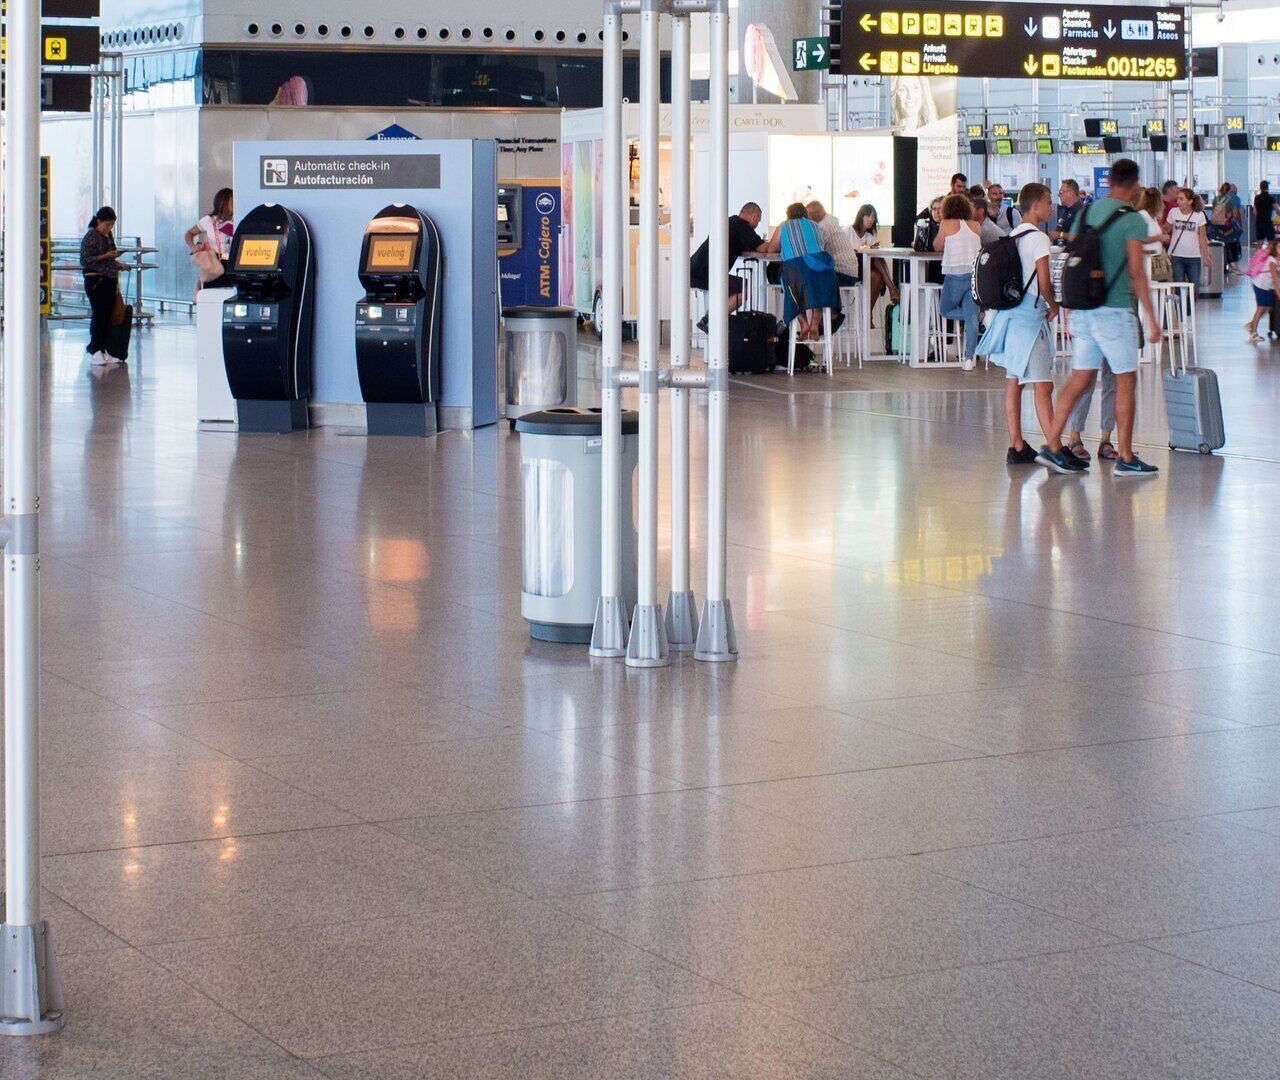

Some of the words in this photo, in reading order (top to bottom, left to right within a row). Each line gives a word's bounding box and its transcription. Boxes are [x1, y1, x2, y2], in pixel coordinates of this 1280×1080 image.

[1062, 28, 1099, 39] Farmacia
[1156, 31, 1179, 40] Aseos
[923, 44, 947, 53] Ankunft
[923, 54, 947, 63] Arrivals
[922, 63, 959, 74] Llegadas
[1062, 65, 1106, 76] Facturación
[1107, 57, 1139, 77] 001
[1145, 57, 1177, 77] 265
[734, 117, 762, 128] CARTE
[1101, 122, 1116, 134] 342
[1148, 120, 1163, 132] 343
[1178, 119, 1188, 131] 34
[1227, 117, 1242, 130] 345
[967, 125, 981, 137] 339
[994, 125, 1007, 137] 340
[1034, 123, 1048, 135] 341
[294, 161, 346, 171] Automatic
[349, 160, 390, 171] check-in
[293, 174, 374, 185] Autofacturación
[246, 246, 272, 260] vueling
[377, 245, 405, 260] vueling
